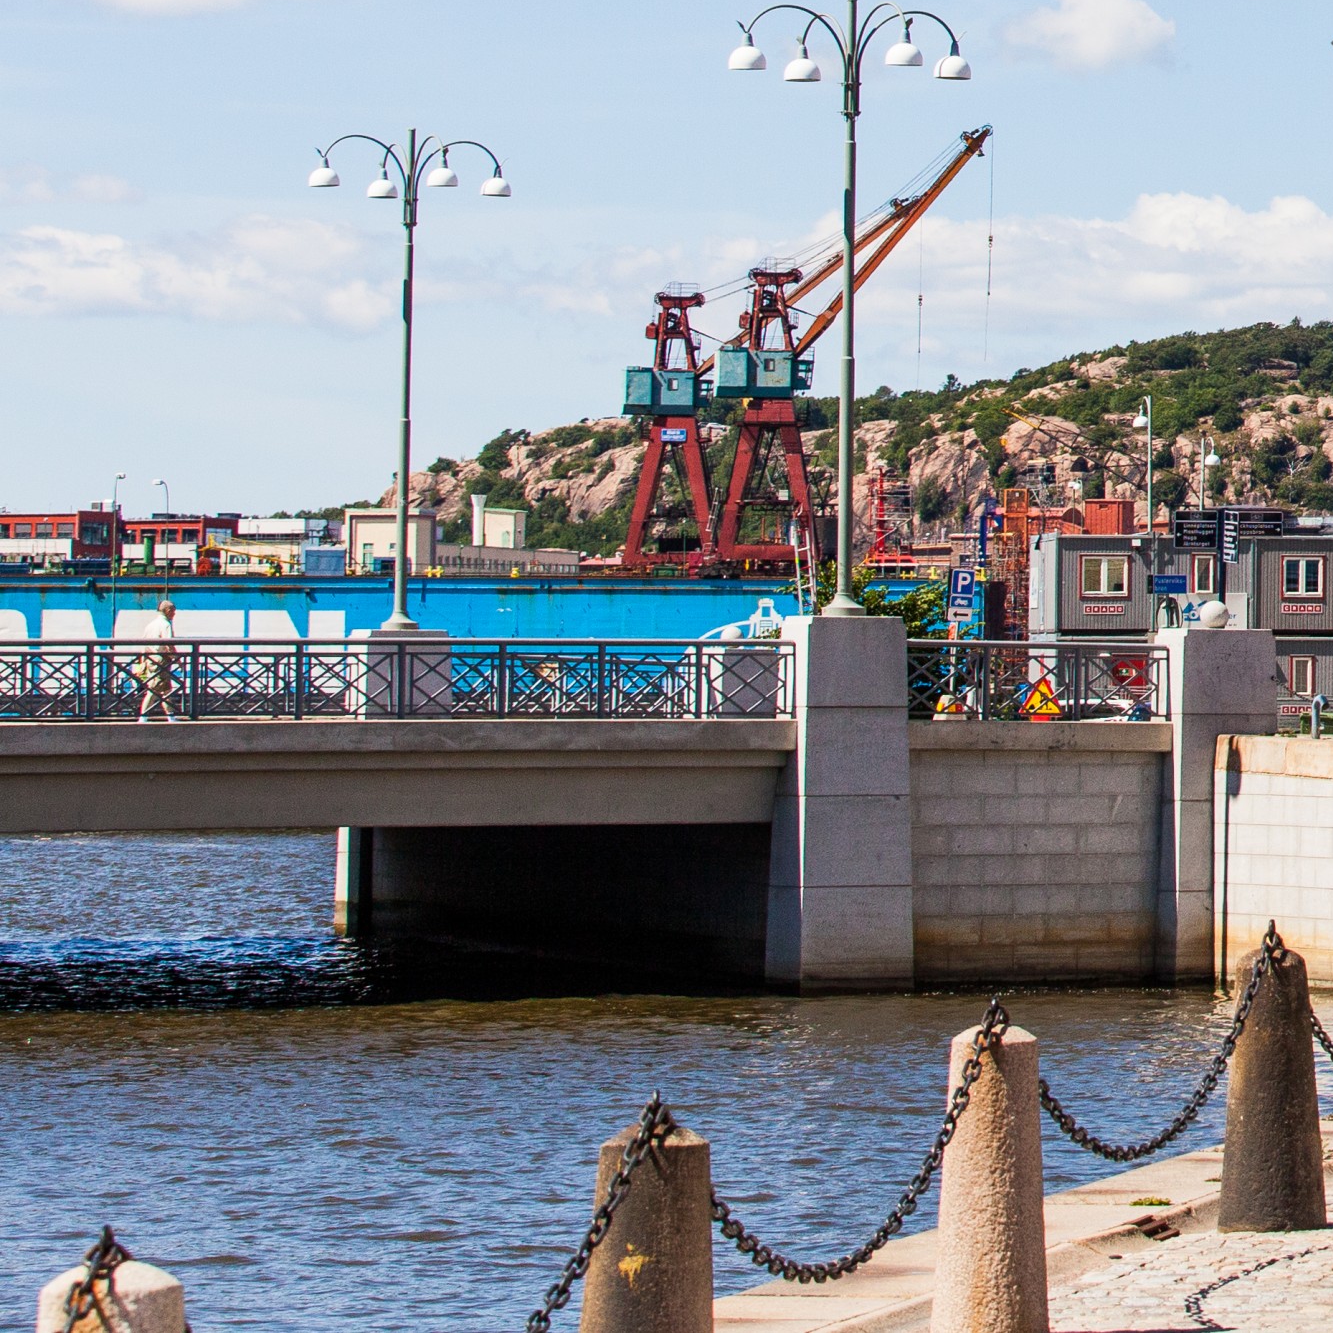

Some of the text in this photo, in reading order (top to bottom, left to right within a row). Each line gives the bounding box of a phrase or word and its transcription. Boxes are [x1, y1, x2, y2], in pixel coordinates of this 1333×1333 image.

[957, 573, 971, 592] P
[1086, 605, 1123, 613] CRAMO
[1284, 604, 1321, 612] CRAMO
